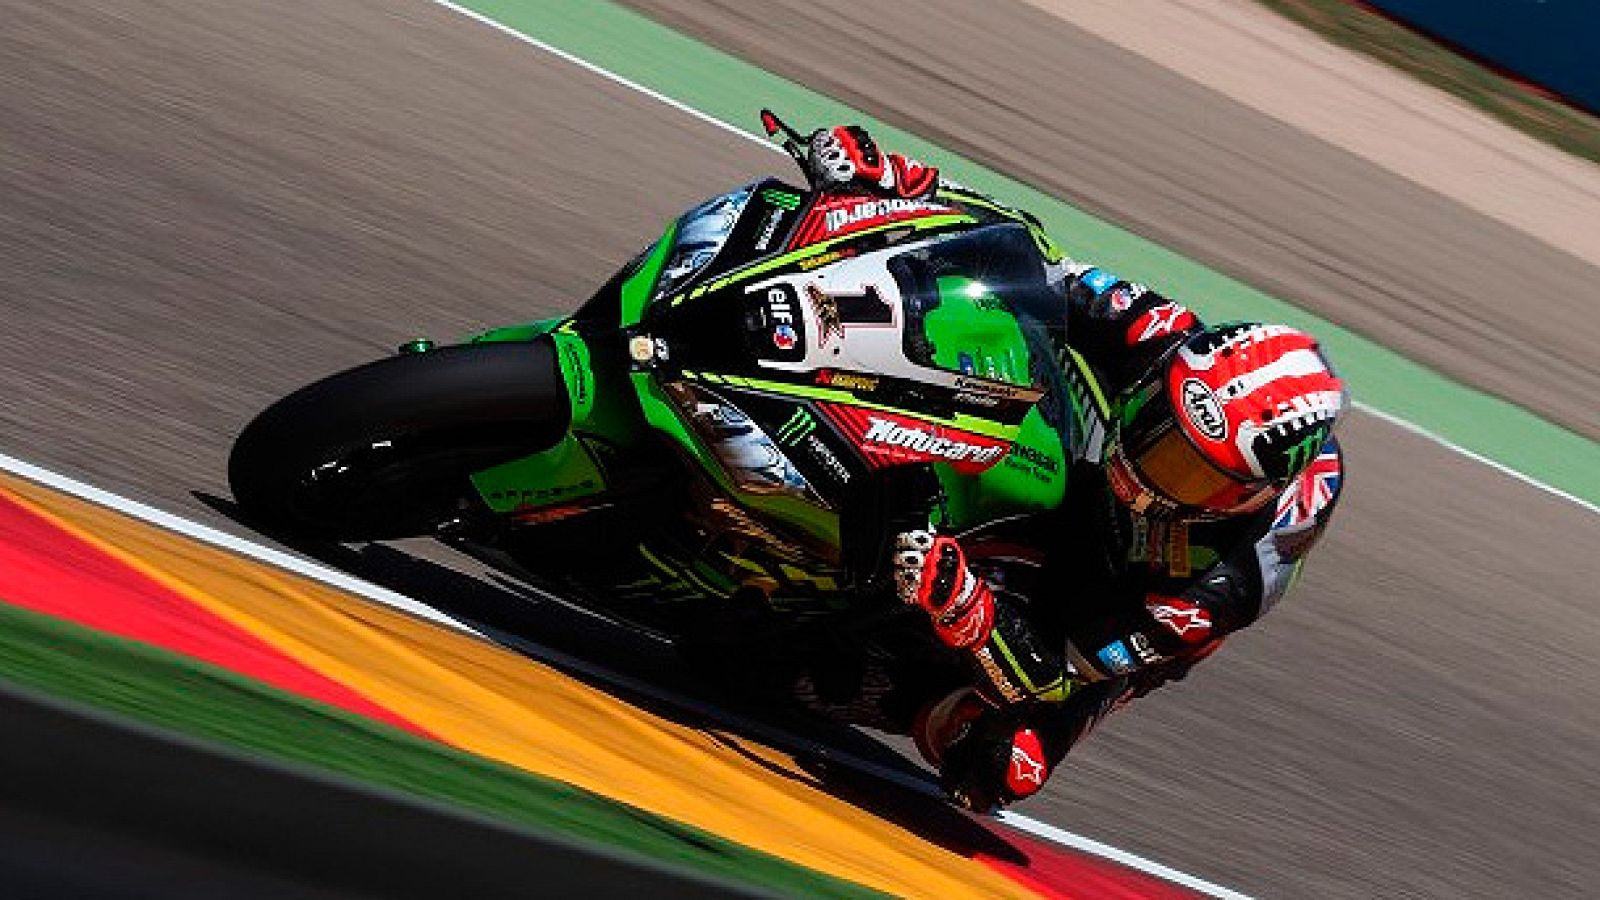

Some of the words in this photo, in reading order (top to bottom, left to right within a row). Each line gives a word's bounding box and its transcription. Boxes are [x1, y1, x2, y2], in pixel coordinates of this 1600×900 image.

[768, 288, 793, 324] elf
[833, 285, 896, 327] 1
[1185, 387, 1224, 437] Arai
